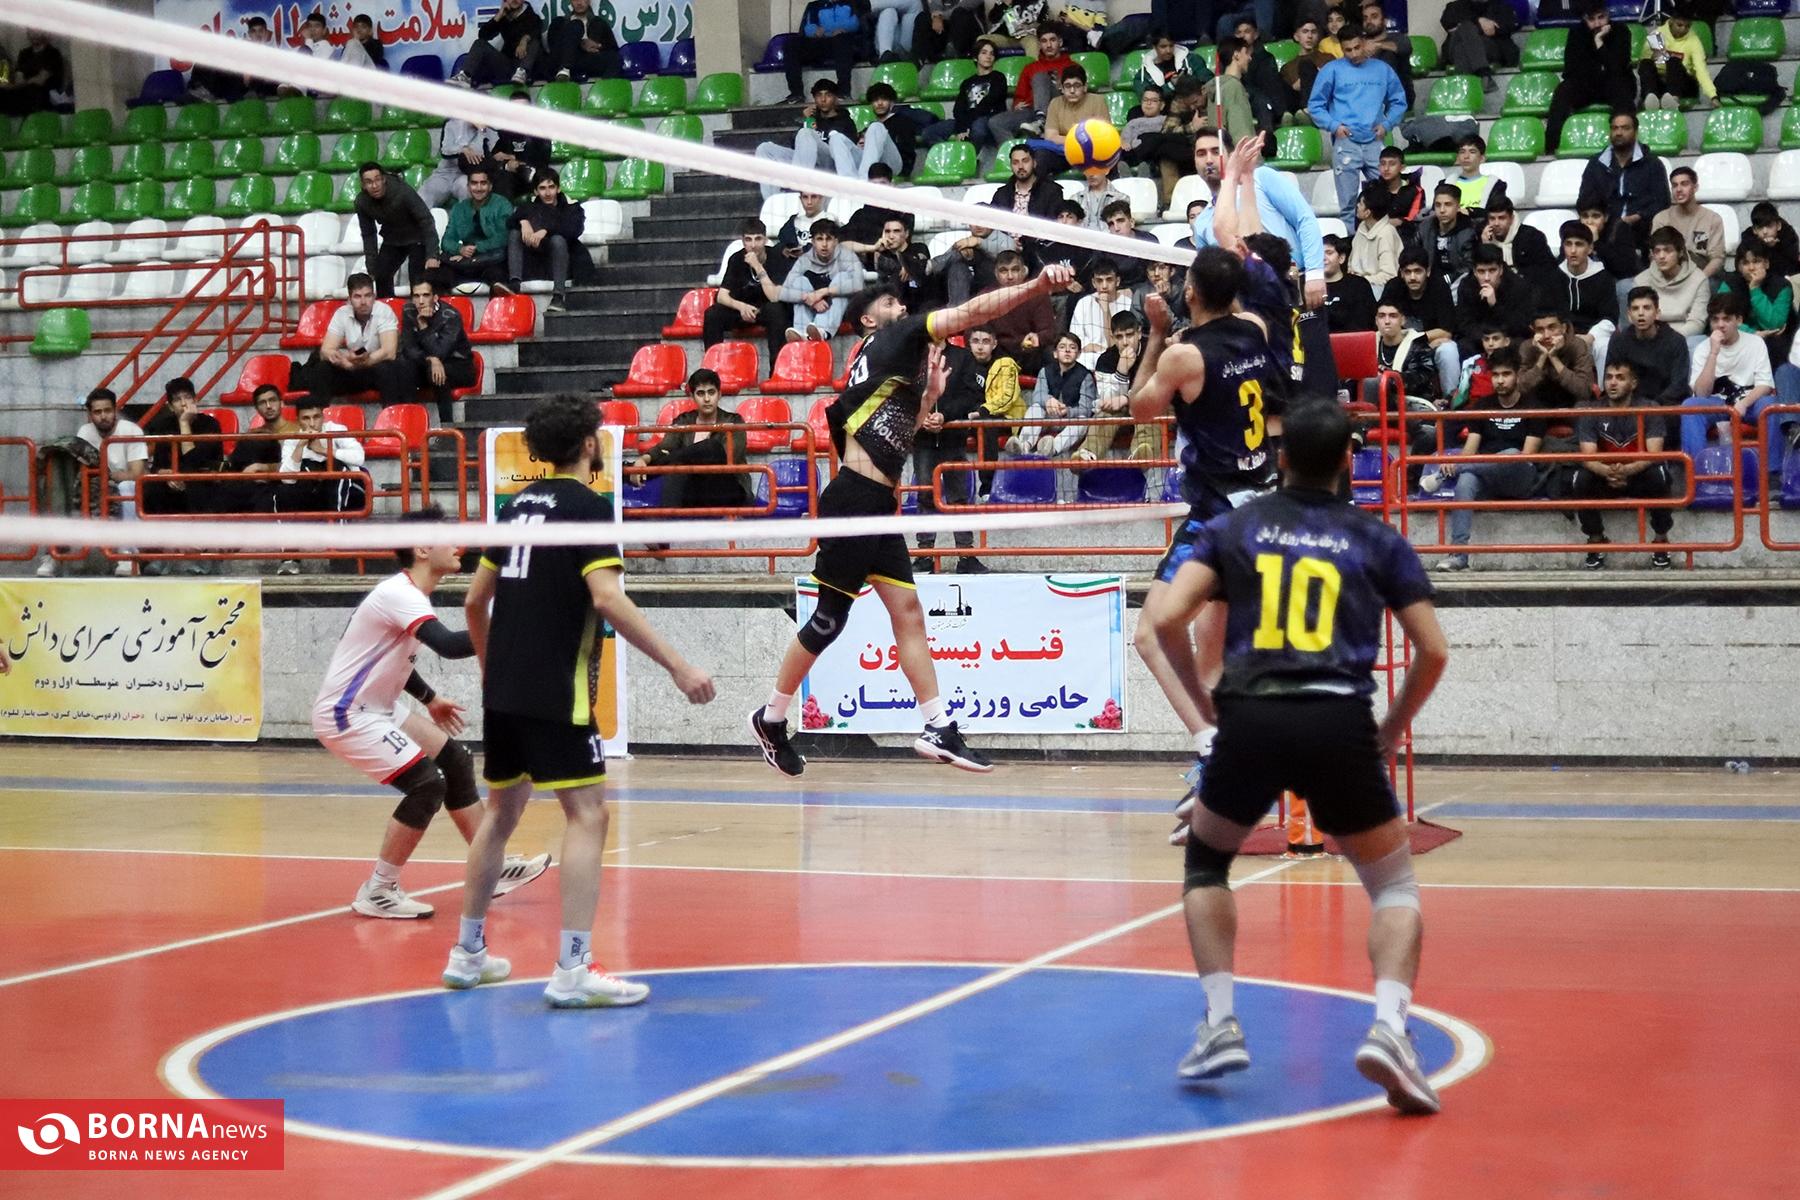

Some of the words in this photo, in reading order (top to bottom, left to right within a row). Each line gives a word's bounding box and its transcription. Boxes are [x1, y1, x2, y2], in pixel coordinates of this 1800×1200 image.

[1238, 379, 1265, 451] 3
[1253, 554, 1341, 652] 10
[8, 601, 58, 660] دانش
[60, 624, 121, 663] سرای
[122, 598, 208, 663] آموزشی
[200, 597, 245, 669] مجتمع
[991, 628, 1065, 661] قند
[837, 685, 917, 718] ستان
[1019, 685, 1089, 718] حامی
[382, 730, 408, 755] 18
